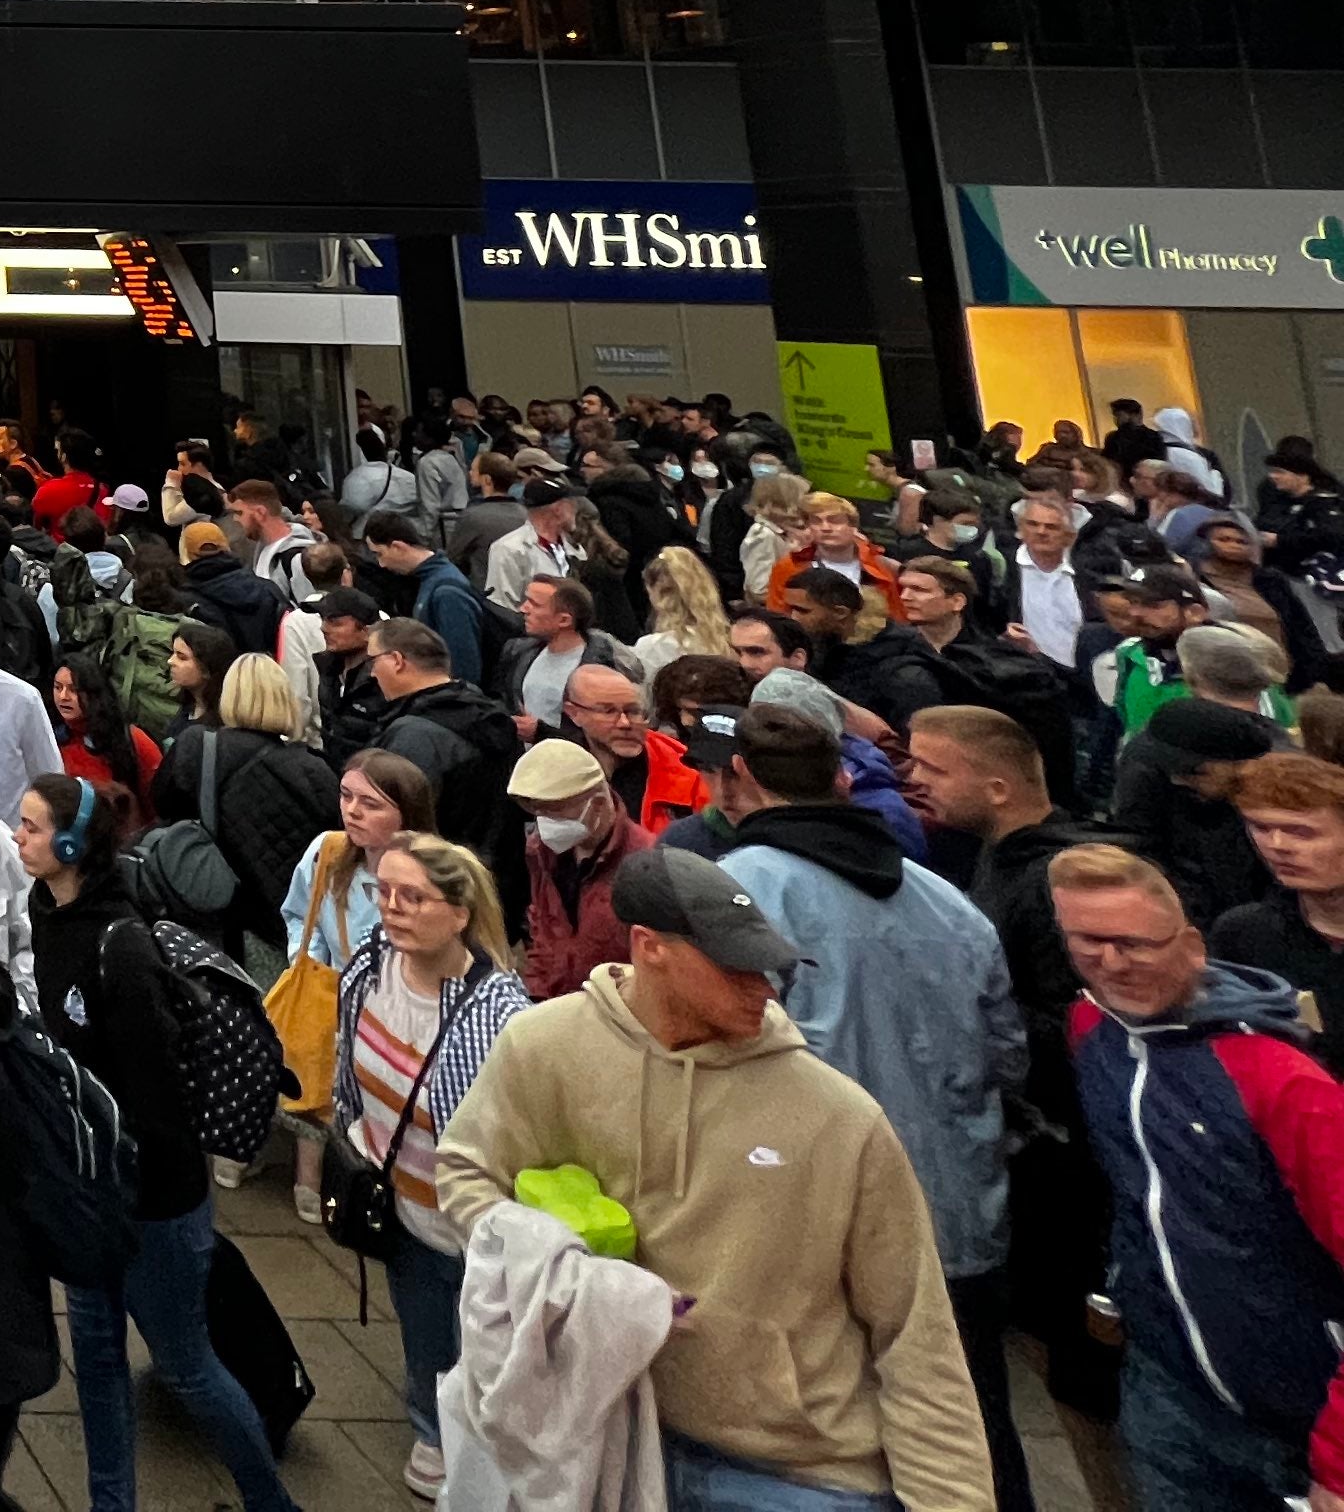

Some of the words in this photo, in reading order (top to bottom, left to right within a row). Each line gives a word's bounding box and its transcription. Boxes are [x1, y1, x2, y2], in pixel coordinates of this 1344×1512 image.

[482, 248, 523, 266] EST
[514, 211, 767, 270] WHSmi
[1056, 223, 1153, 270] well
